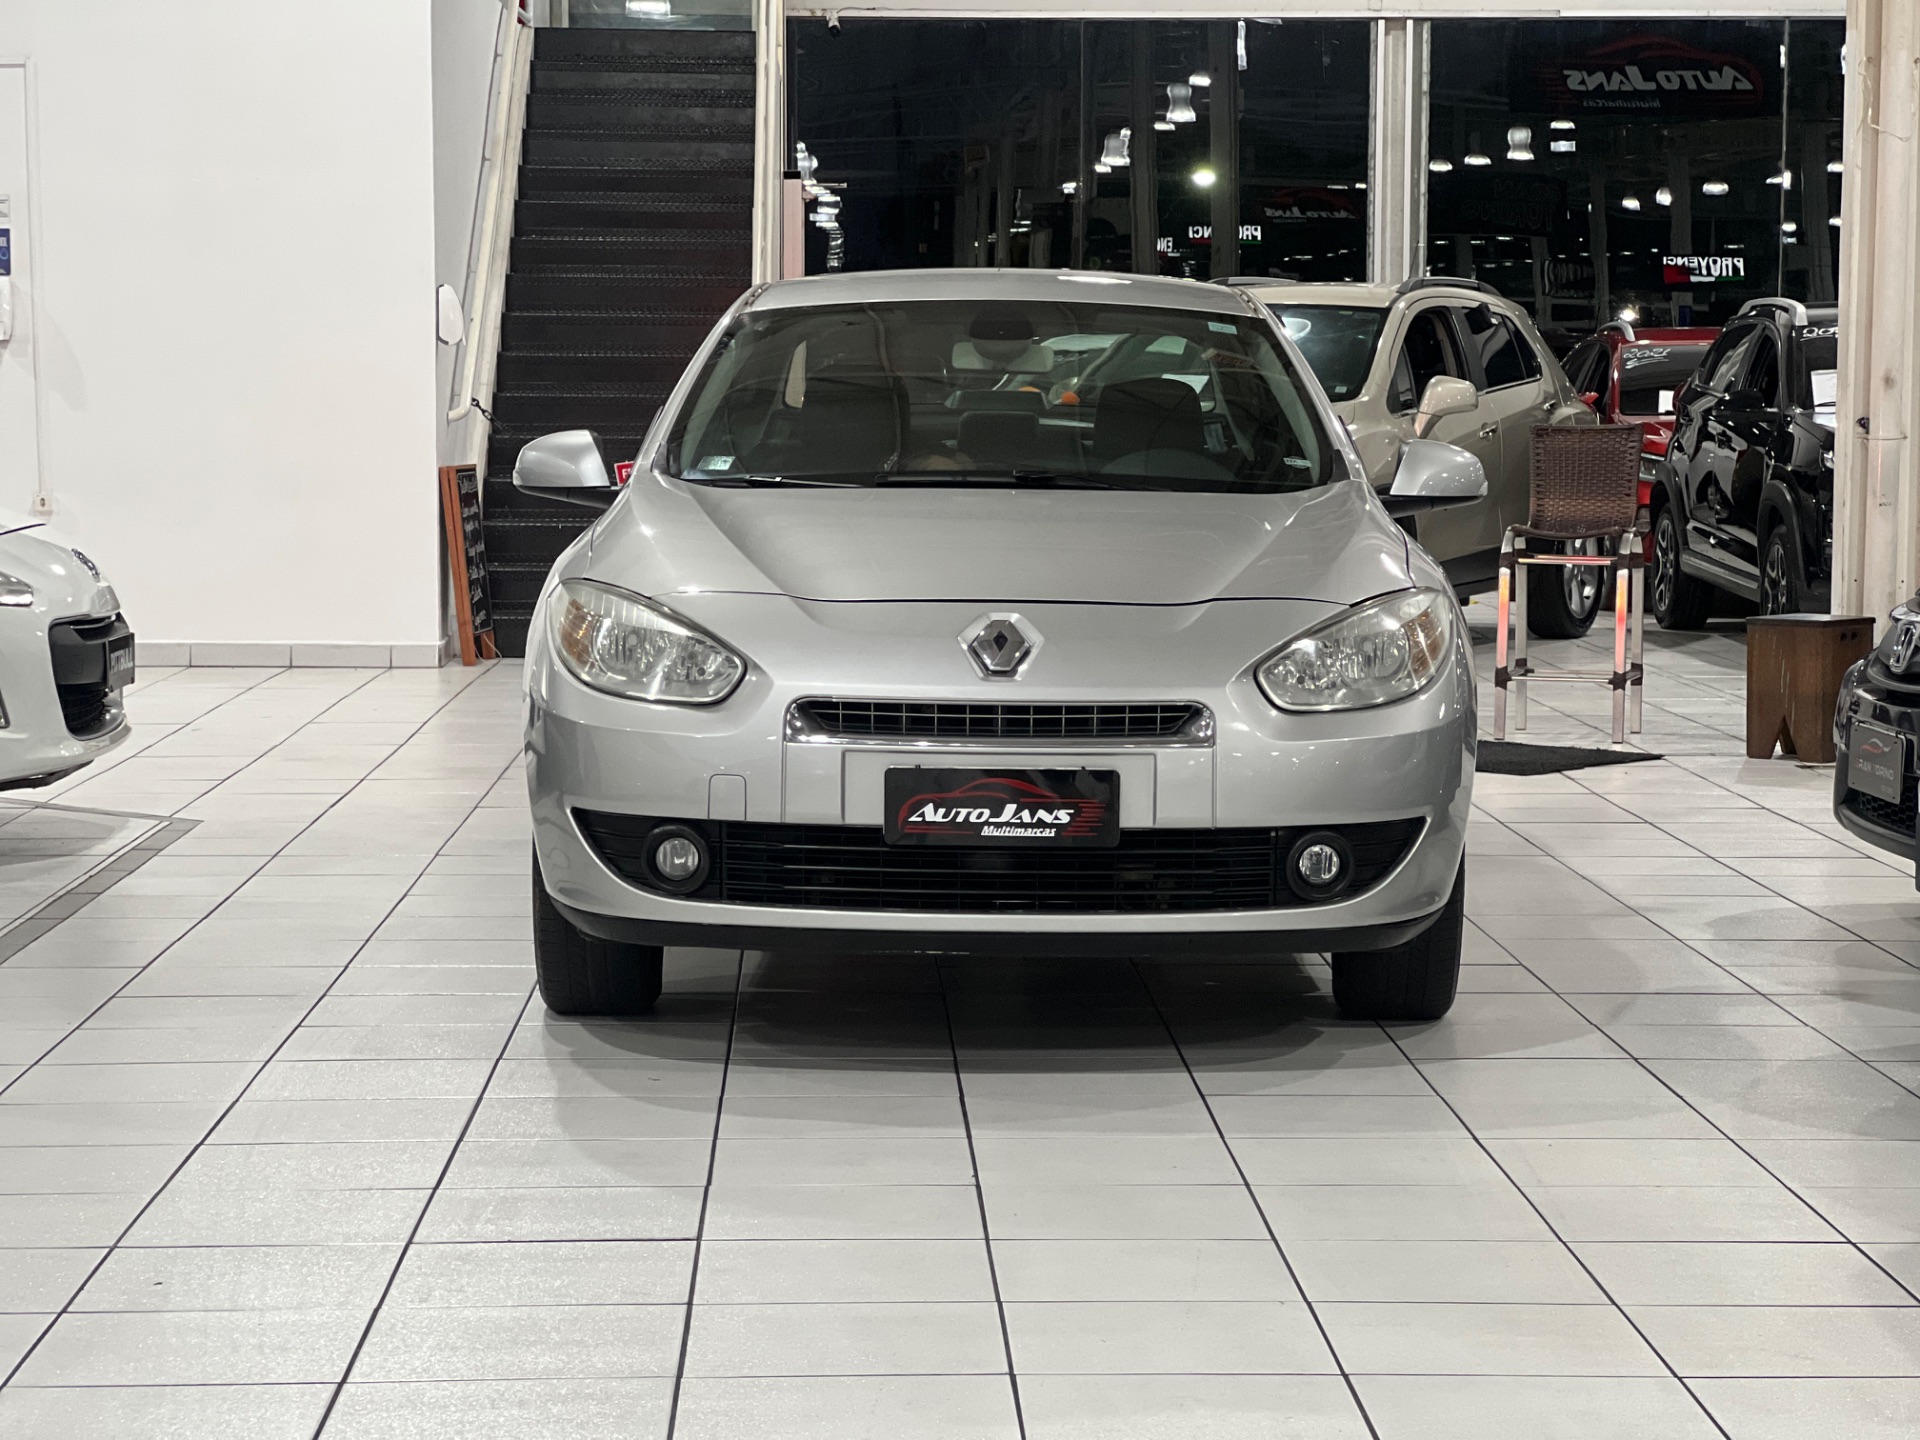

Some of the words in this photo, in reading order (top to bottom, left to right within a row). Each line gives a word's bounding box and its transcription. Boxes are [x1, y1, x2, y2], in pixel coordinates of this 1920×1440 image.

[1803, 327, 1838, 338] 20
[908, 802, 990, 823] AUTO
[988, 804, 1074, 824] JANS
[981, 825, 1055, 836] Multimarcas
